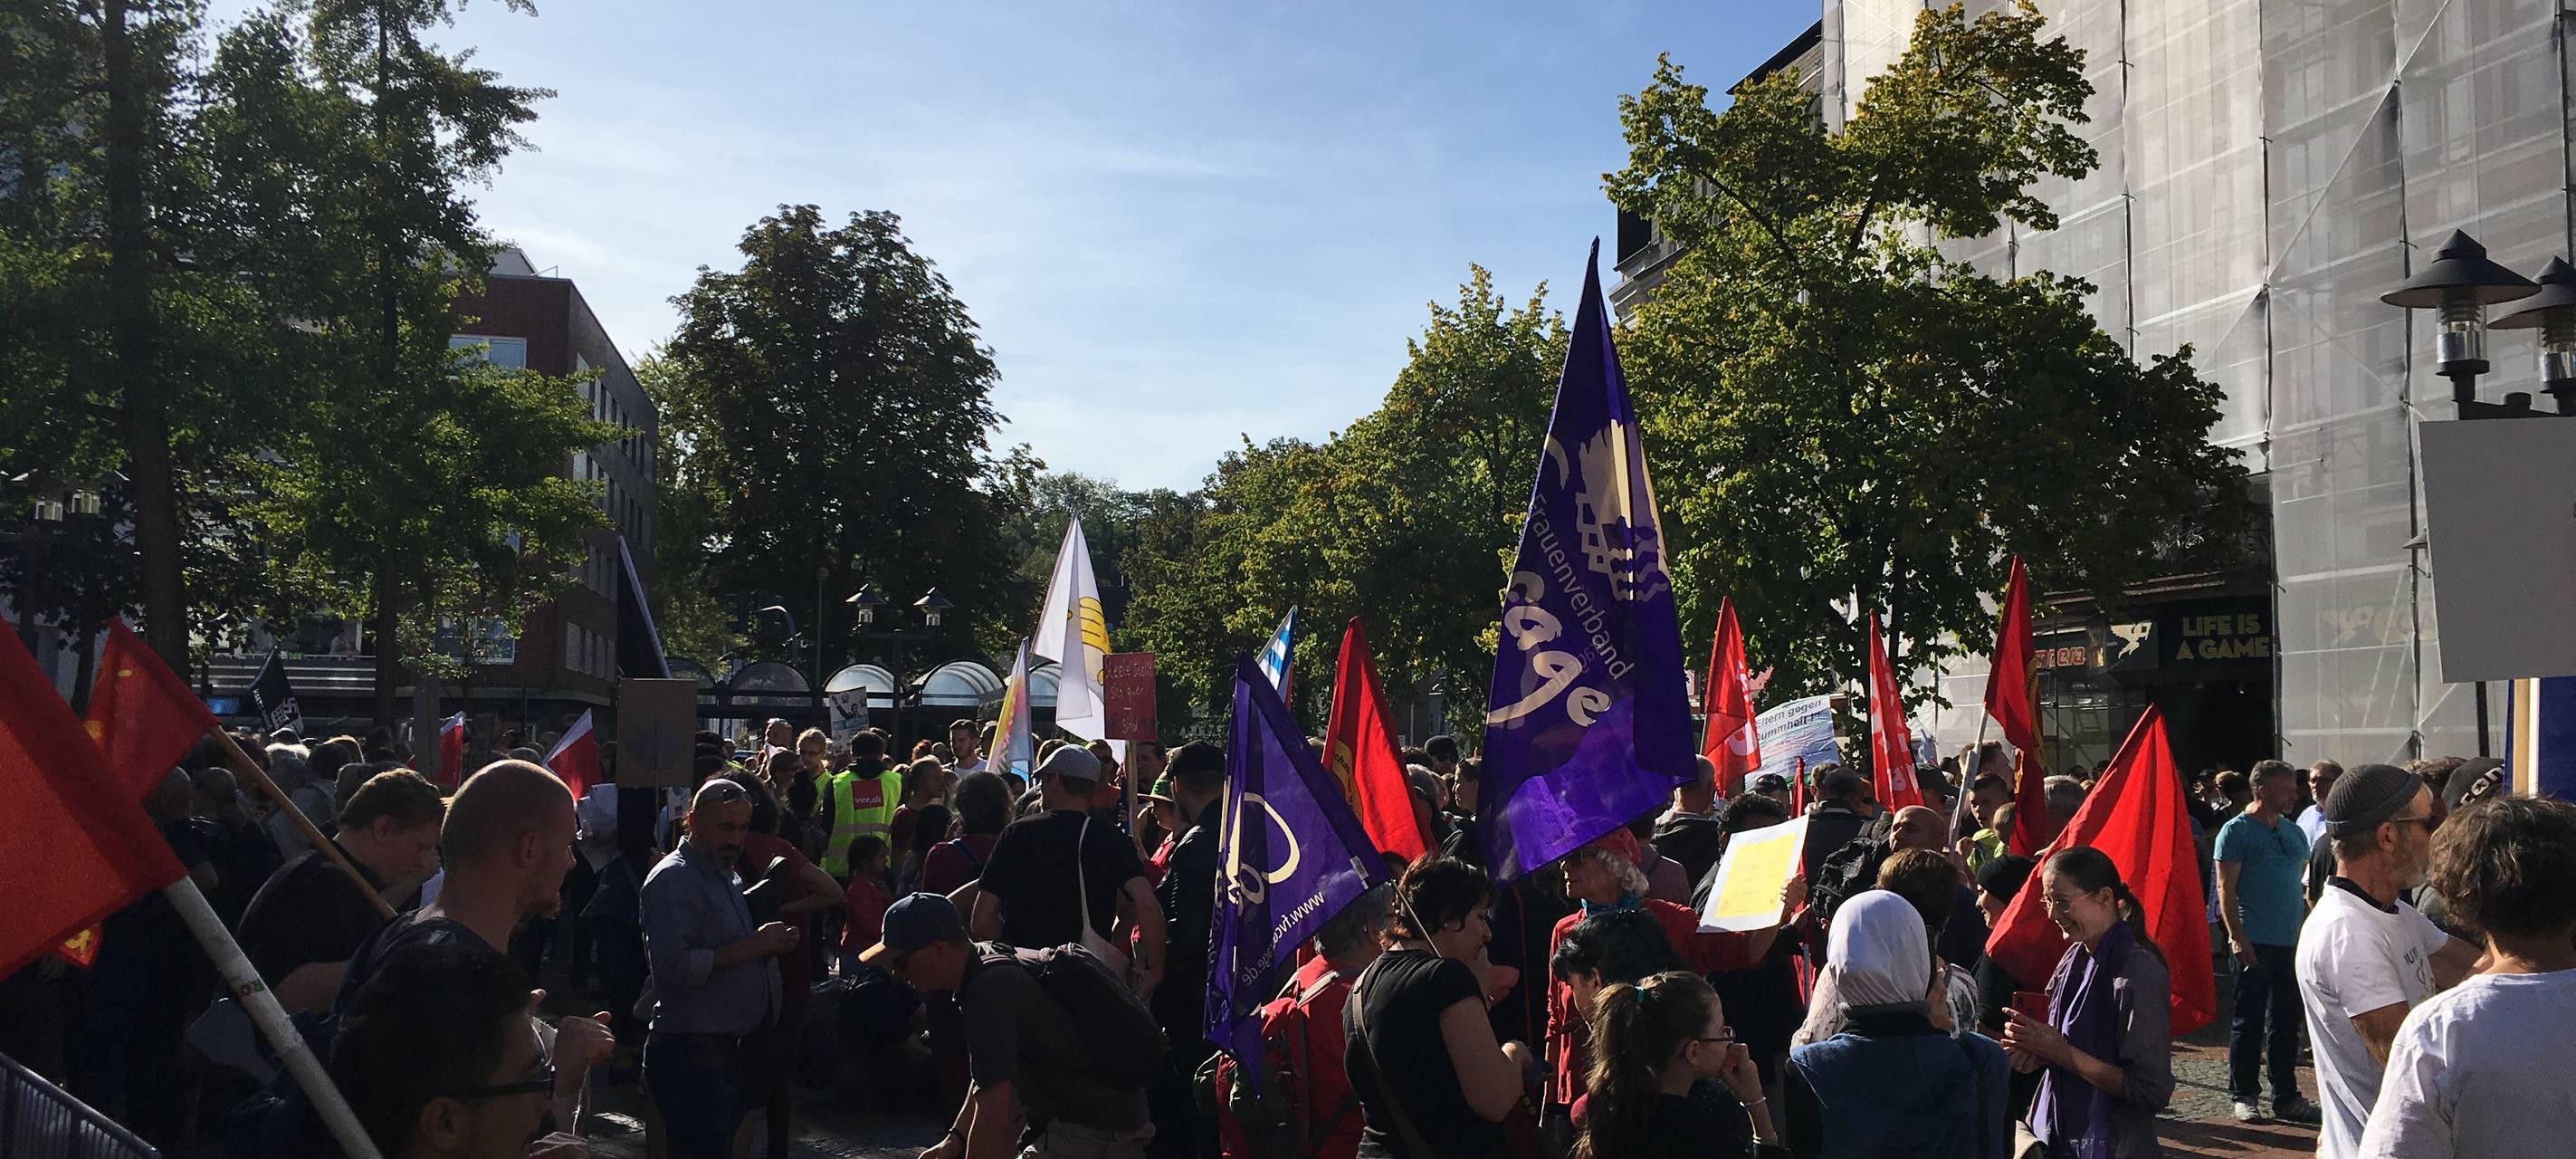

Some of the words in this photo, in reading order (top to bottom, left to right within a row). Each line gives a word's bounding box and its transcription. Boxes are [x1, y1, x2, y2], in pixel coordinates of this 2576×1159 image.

[2182, 615, 2231, 637] LIFE
[2237, 613, 2262, 633] IS
[2176, 639, 2194, 660] A
[2199, 637, 2270, 659] GAME
[854, 795, 882, 804] ver.di
